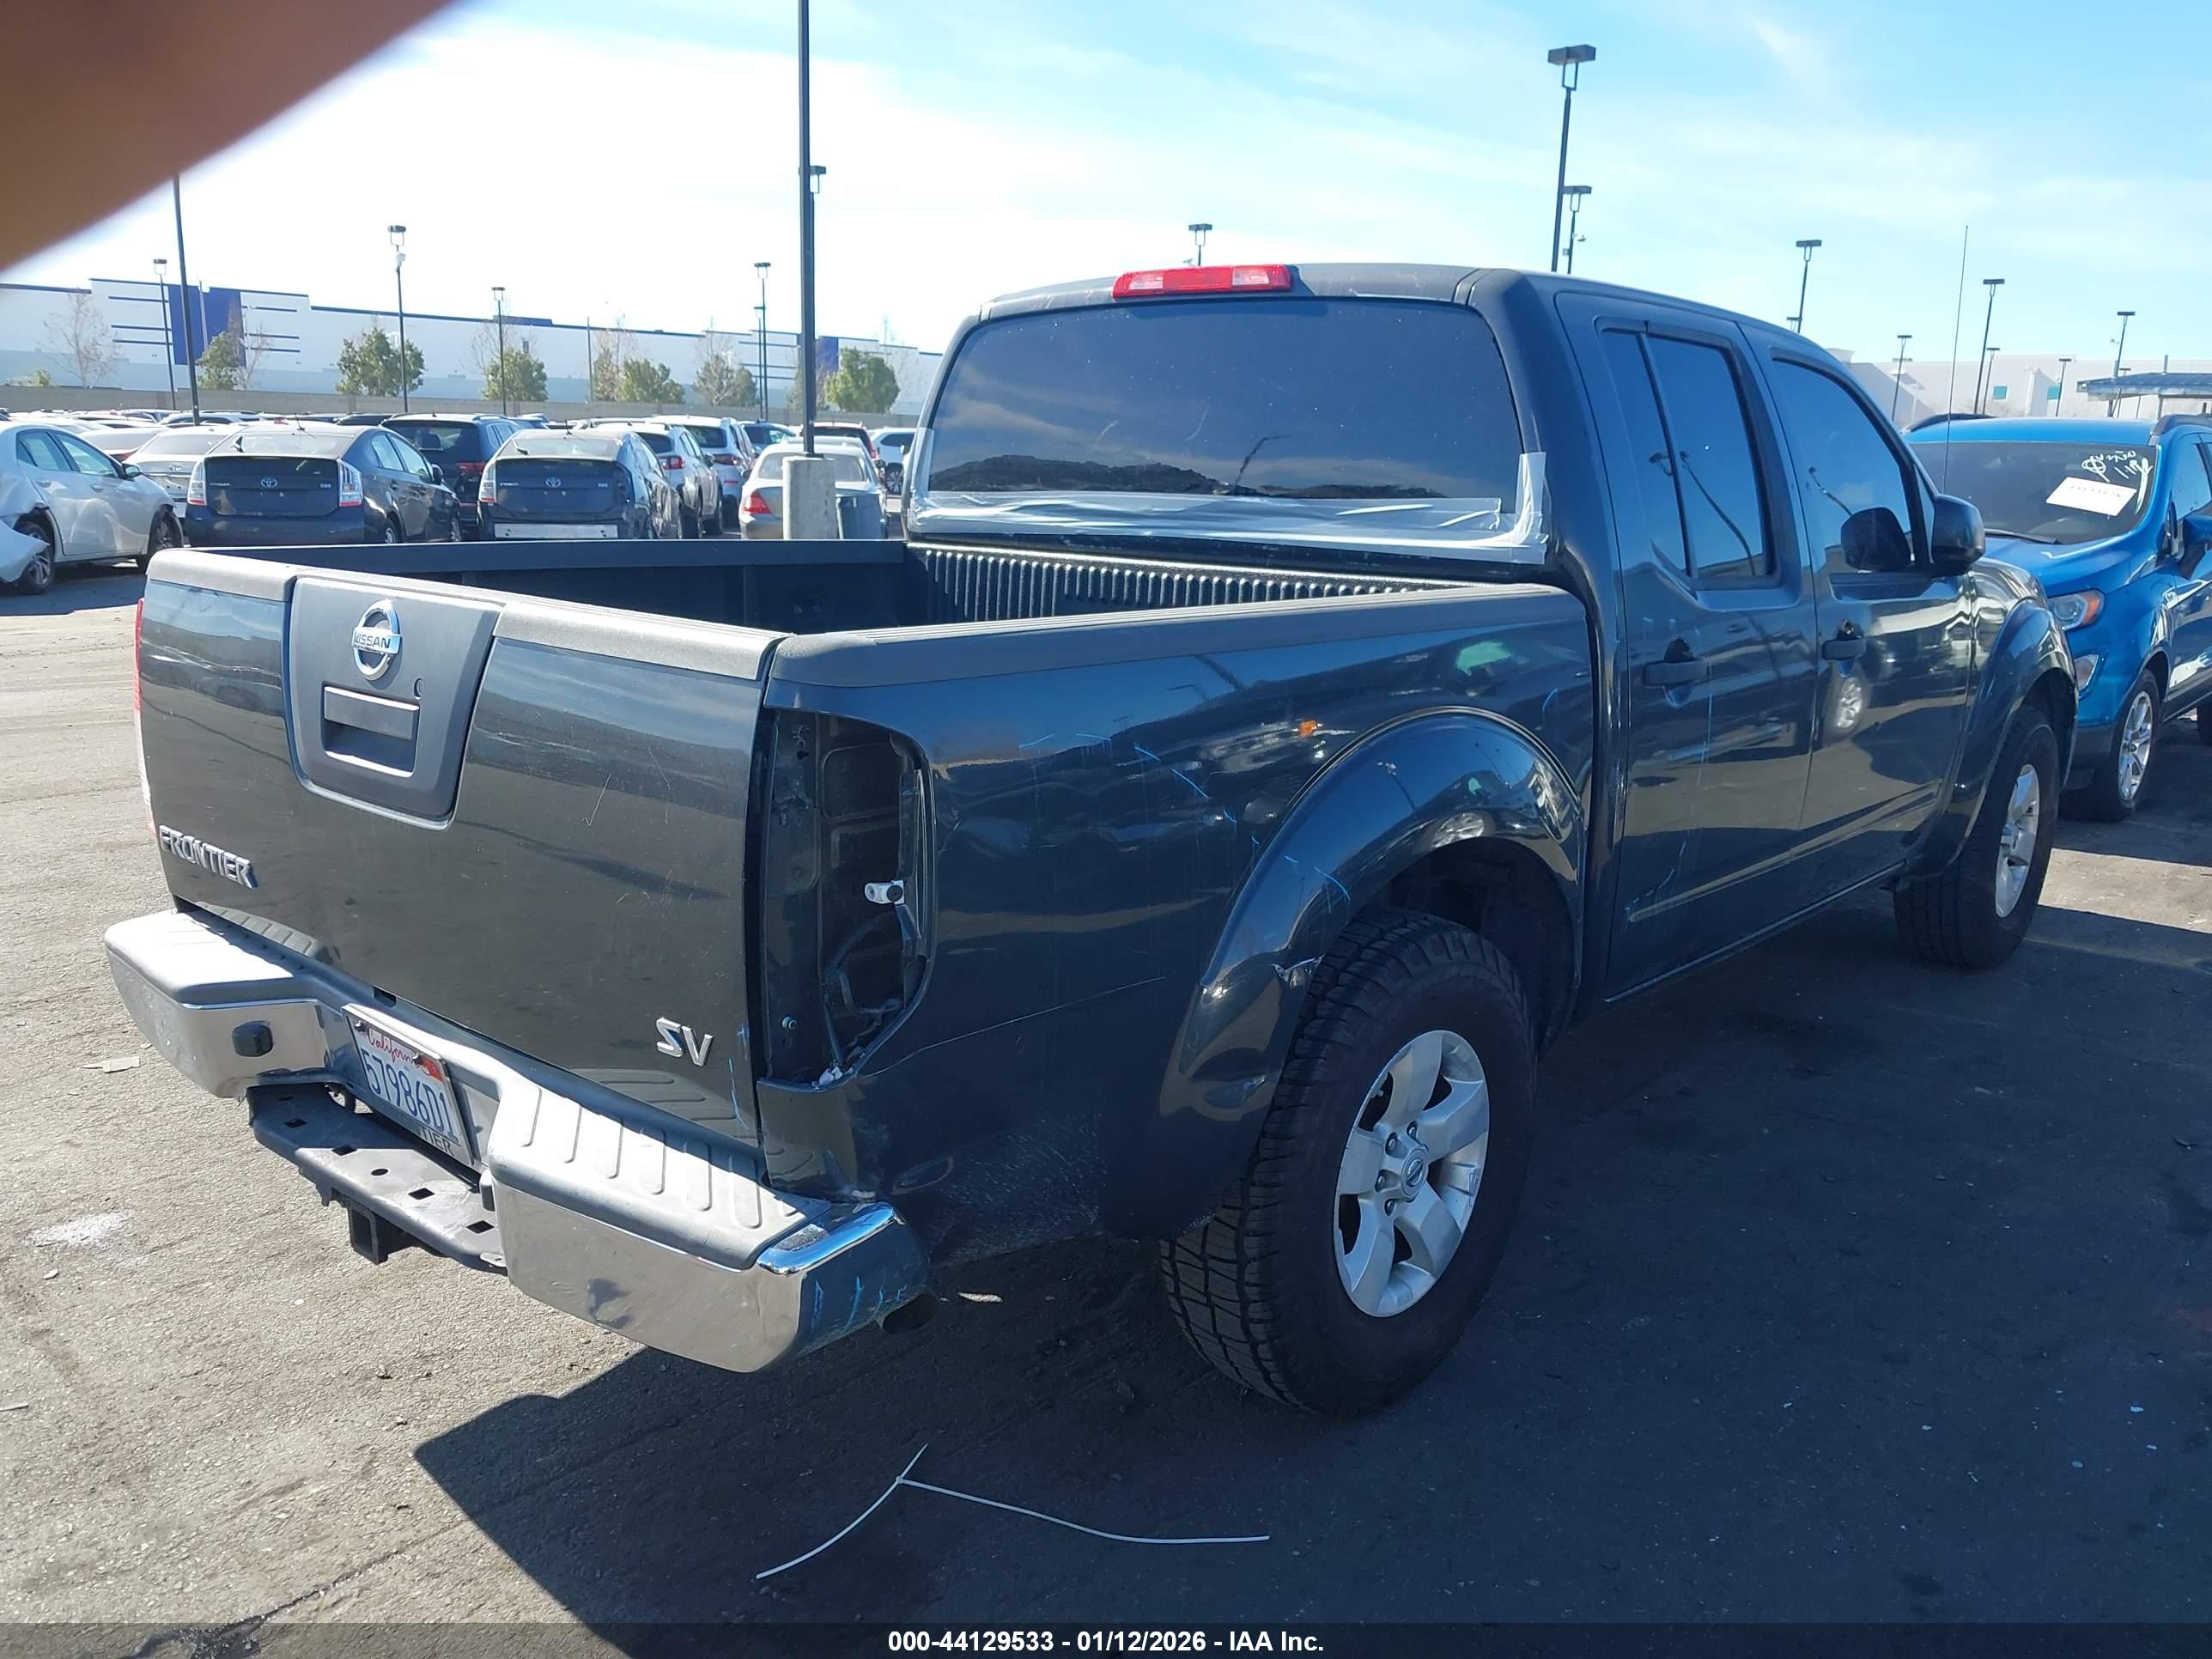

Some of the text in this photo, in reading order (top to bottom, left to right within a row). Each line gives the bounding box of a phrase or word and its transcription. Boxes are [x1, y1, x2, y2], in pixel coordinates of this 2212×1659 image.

[353, 632, 392, 649] NISSAN
[159, 824, 258, 889] FRONTIER
[656, 1017, 714, 1066] SV
[360, 1047, 459, 1145] 57986D1
